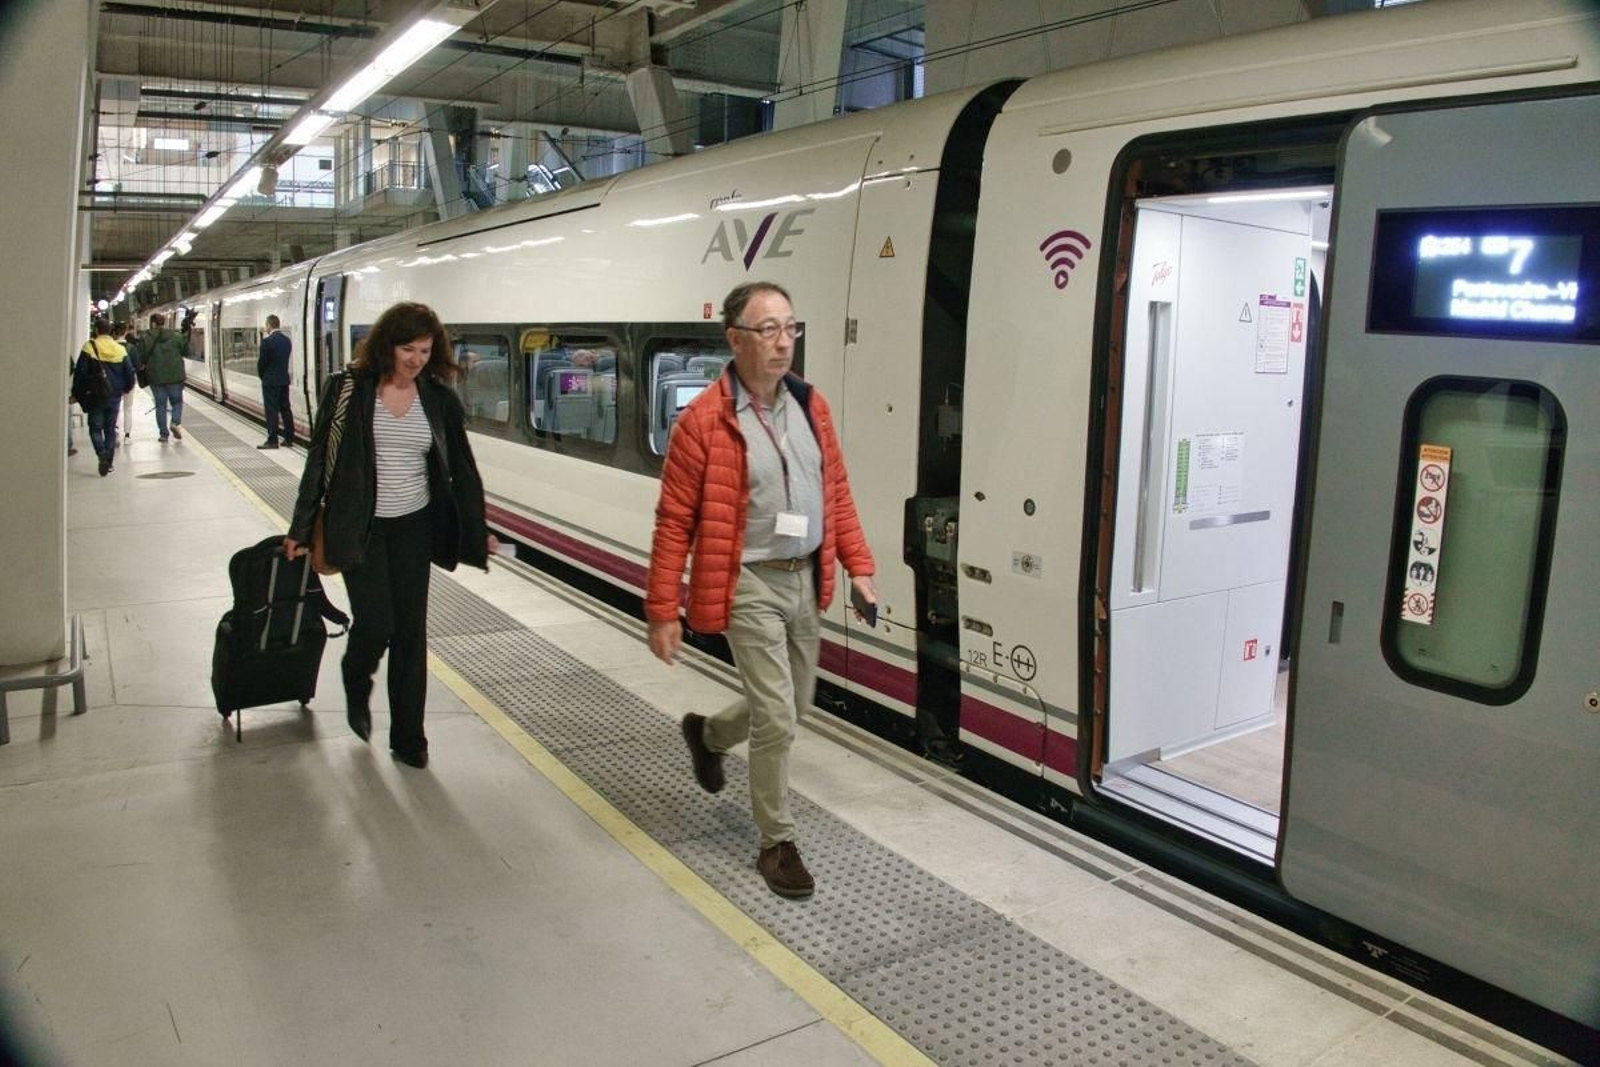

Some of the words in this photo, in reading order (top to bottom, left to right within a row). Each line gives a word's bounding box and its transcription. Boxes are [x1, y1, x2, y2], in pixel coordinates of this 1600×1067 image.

[703, 209, 815, 271] AVE
[1509, 238, 1534, 275] 7
[967, 648, 988, 667] 12R
